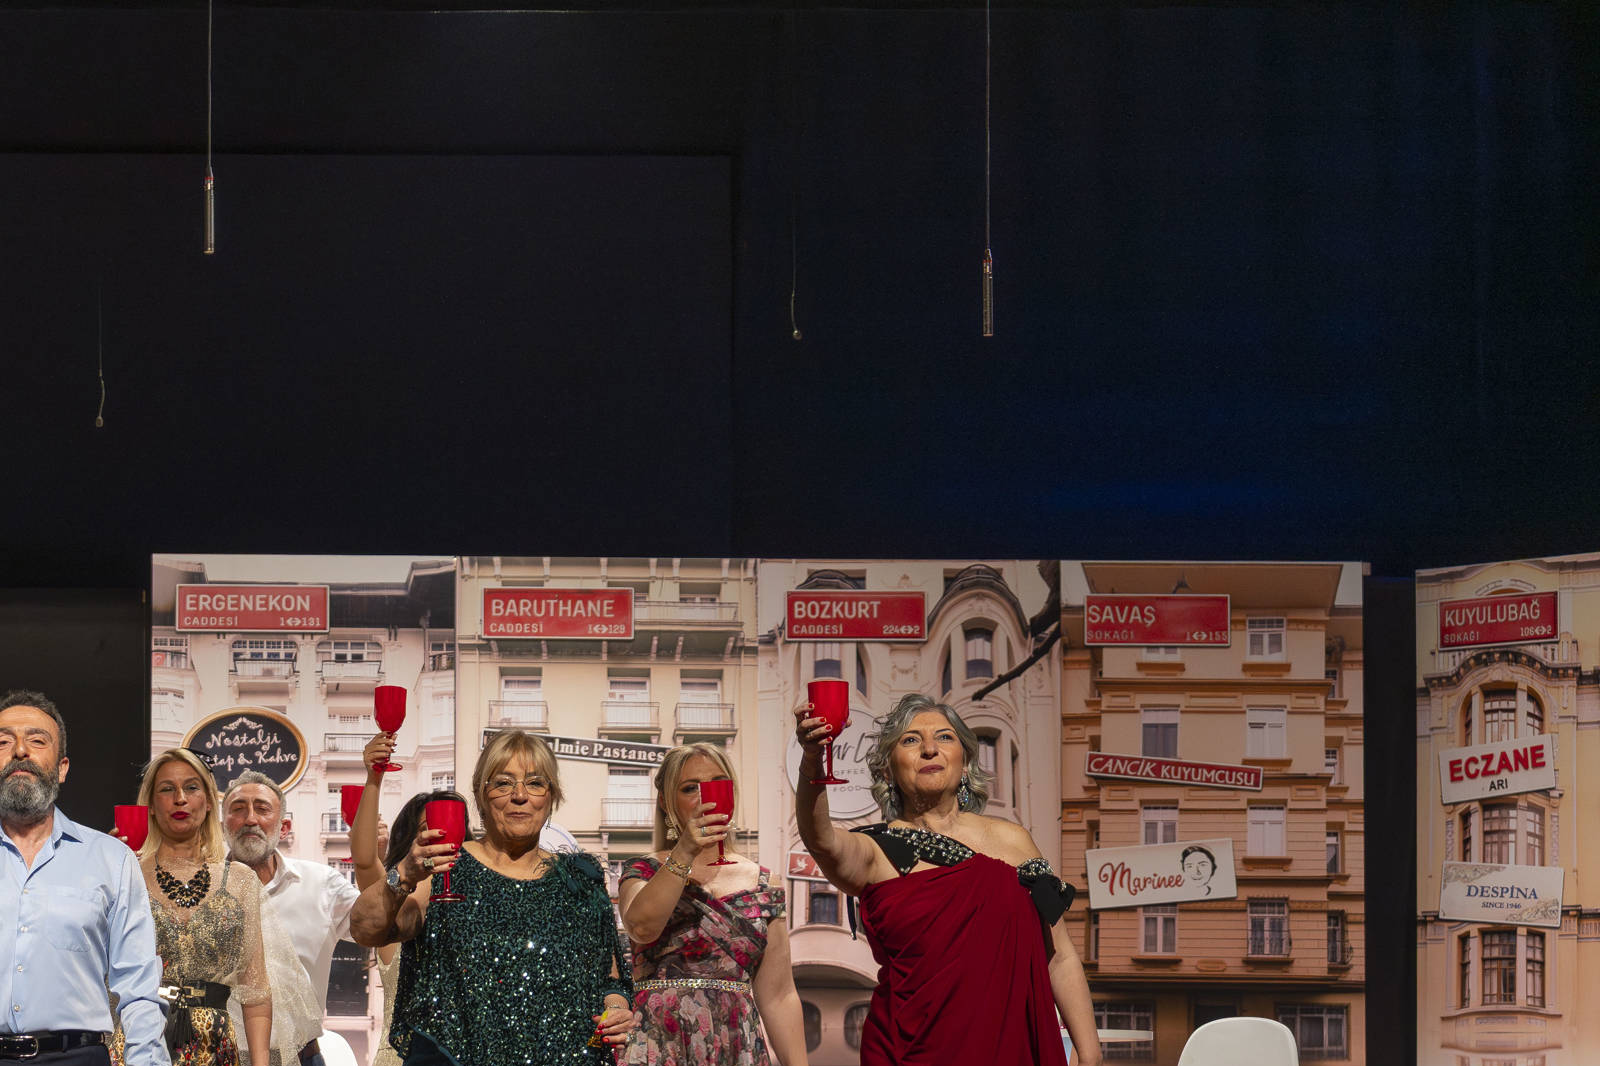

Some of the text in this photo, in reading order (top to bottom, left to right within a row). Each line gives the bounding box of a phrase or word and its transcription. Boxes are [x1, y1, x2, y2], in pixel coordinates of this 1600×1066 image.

[185, 594, 310, 612] ERGENEKON
[491, 599, 615, 617] BARUTHANE
[794, 600, 880, 619] BOZKURT
[184, 615, 238, 626] CADDESİ
[1088, 604, 1156, 628] SAVAŞ
[1445, 598, 1540, 628] KUYULUBAĞ
[490, 621, 543, 633] CADDESİ
[792, 623, 843, 635] CADDESİ
[205, 729, 281, 751] Nostalji
[254, 748, 298, 764] Kahve
[593, 742, 667, 763] Pastanes
[1449, 744, 1546, 782] ECZANE
[1160, 765, 1255, 786] KUYUMCUSU
[1489, 778, 1508, 792] ARI
[1099, 861, 1185, 896] Marinee
[1466, 884, 1539, 900] DESPİNA
[1481, 901, 1504, 909] SINCE
